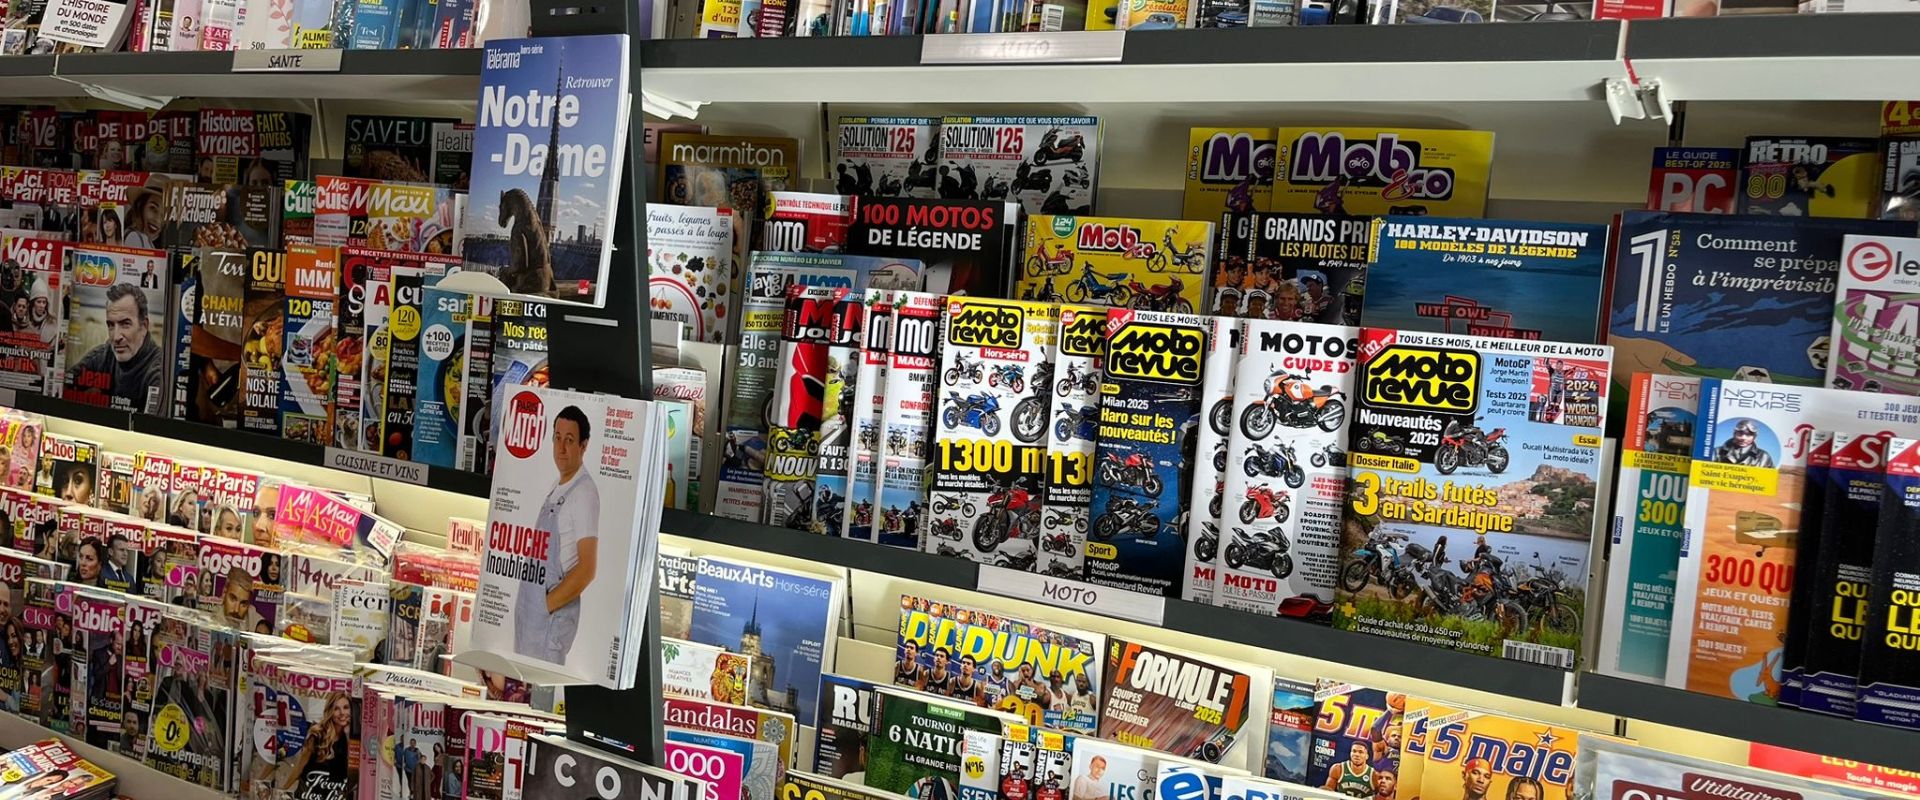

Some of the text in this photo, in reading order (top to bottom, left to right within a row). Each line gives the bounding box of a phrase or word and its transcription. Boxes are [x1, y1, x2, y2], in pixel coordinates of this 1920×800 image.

[57, 7, 108, 25] DU MONDE
[486, 49, 521, 70] Télérama
[566, 76, 613, 89] Retrouver
[480, 85, 580, 128] Notre
[200, 111, 255, 133] Histoires
[257, 113, 287, 132] FAITS
[1003, 117, 1017, 125] TOUT
[1018, 117, 1025, 125] CE
[1026, 117, 1037, 125] QUE
[1038, 117, 1051, 125] VOUS
[1052, 117, 1069, 125] DEVEZ
[259, 131, 293, 148] DIVERS
[843, 127, 916, 153] SOLUTION 125
[946, 126, 1024, 154] SOLUTION 125
[673, 142, 784, 167] marmiton
[1665, 151, 1718, 160] LE GUIDE
[49, 188, 71, 203] LIFE
[1660, 172, 1728, 214] PC
[1748, 173, 1787, 199] 80
[182, 186, 222, 210] Femme
[371, 189, 431, 216] Maxi
[863, 204, 994, 230] 100 MOTOS
[868, 226, 982, 250] DE LÉGENDE
[1265, 217, 1335, 242] GRANDS
[1387, 223, 1588, 248] HARLEY-DAVIDSON
[1280, 243, 1365, 260] LES PILOTES DE
[1394, 240, 1577, 259] 100 MODÈLES DE LÉGENDE
[1696, 233, 1798, 253] Comment
[6, 239, 53, 271] Voici
[1754, 256, 1773, 269] se
[288, 299, 311, 317] 120
[1661, 263, 1676, 334] LE UN HEBDO
[1417, 303, 1489, 319] NITE OWL
[503, 321, 547, 340] Nos rec
[984, 349, 1028, 361] Hors-série
[1399, 335, 1604, 358] TOUS LES MOIS, LE MEILLEUR DE LA MOTO
[739, 352, 779, 370] 50 ans
[1283, 356, 1332, 373] GUIDE
[1494, 357, 1531, 369] MotoGP
[78, 367, 112, 390] Jean
[1489, 367, 1507, 378] Jorge
[653, 383, 705, 400] de Noël
[1486, 390, 1528, 401] Tests 2025
[1566, 379, 1598, 393] 2024
[1723, 388, 1802, 403] NOTRE
[1103, 395, 1149, 410] Milan 2025
[1566, 402, 1598, 416] WORLD
[1727, 397, 1802, 413] TEMPS
[504, 399, 547, 450] MATCH
[1101, 408, 1174, 429] Haro sur les
[1360, 408, 1443, 431] Nouveautés
[1565, 414, 1598, 427] CHAMPION
[42, 434, 75, 461] Choc
[1410, 431, 1440, 447] 2025
[144, 456, 171, 475] Actu
[939, 437, 1013, 474] 1300
[1356, 456, 1415, 471] Dossier Italie
[335, 454, 421, 481] CUISINE ET VINS
[216, 469, 256, 493] Paris
[214, 490, 254, 510] Matin
[1353, 471, 1381, 517] 3
[1385, 476, 1498, 507] trails futés
[322, 501, 358, 528] Maxi
[1382, 500, 1514, 534] en Sardaigne
[1639, 499, 1678, 525] 300
[489, 521, 551, 560] COLUCHE
[1088, 543, 1112, 557] Sport
[201, 542, 263, 577] Gossip
[486, 550, 547, 585] Inoubliable
[1092, 559, 1120, 571] MotoGP
[775, 578, 830, 601] Hors-série
[1042, 580, 1097, 606] MOTO
[1224, 573, 1277, 593] MOTO
[1703, 587, 1747, 601] JEUX ET
[72, 603, 122, 633] Public
[1701, 602, 1721, 614] MOTS
[1357, 614, 1377, 627] Guide
[1378, 617, 1403, 631] d'achat
[1404, 621, 1413, 631] de
[1414, 622, 1427, 633] 300
[1434, 625, 1448, 637] 450
[1705, 623, 1739, 636] REMPLIR
[1745, 617, 1773, 631] CARTES
[1357, 624, 1490, 652] Les nouveautés de moyenne cylindrée
[160, 646, 209, 674] Closer
[960, 624, 1095, 688] DUNK
[386, 672, 423, 687] Passion
[1115, 642, 1250, 732] FORMULE 1
[1112, 685, 1144, 704] ÉQUIPES
[1108, 699, 1140, 715] PILOTES
[911, 715, 957, 734] TOURNOI
[1105, 710, 1150, 728] CALENDRIER
[889, 725, 901, 742] 6
[964, 760, 985, 774] N°16
